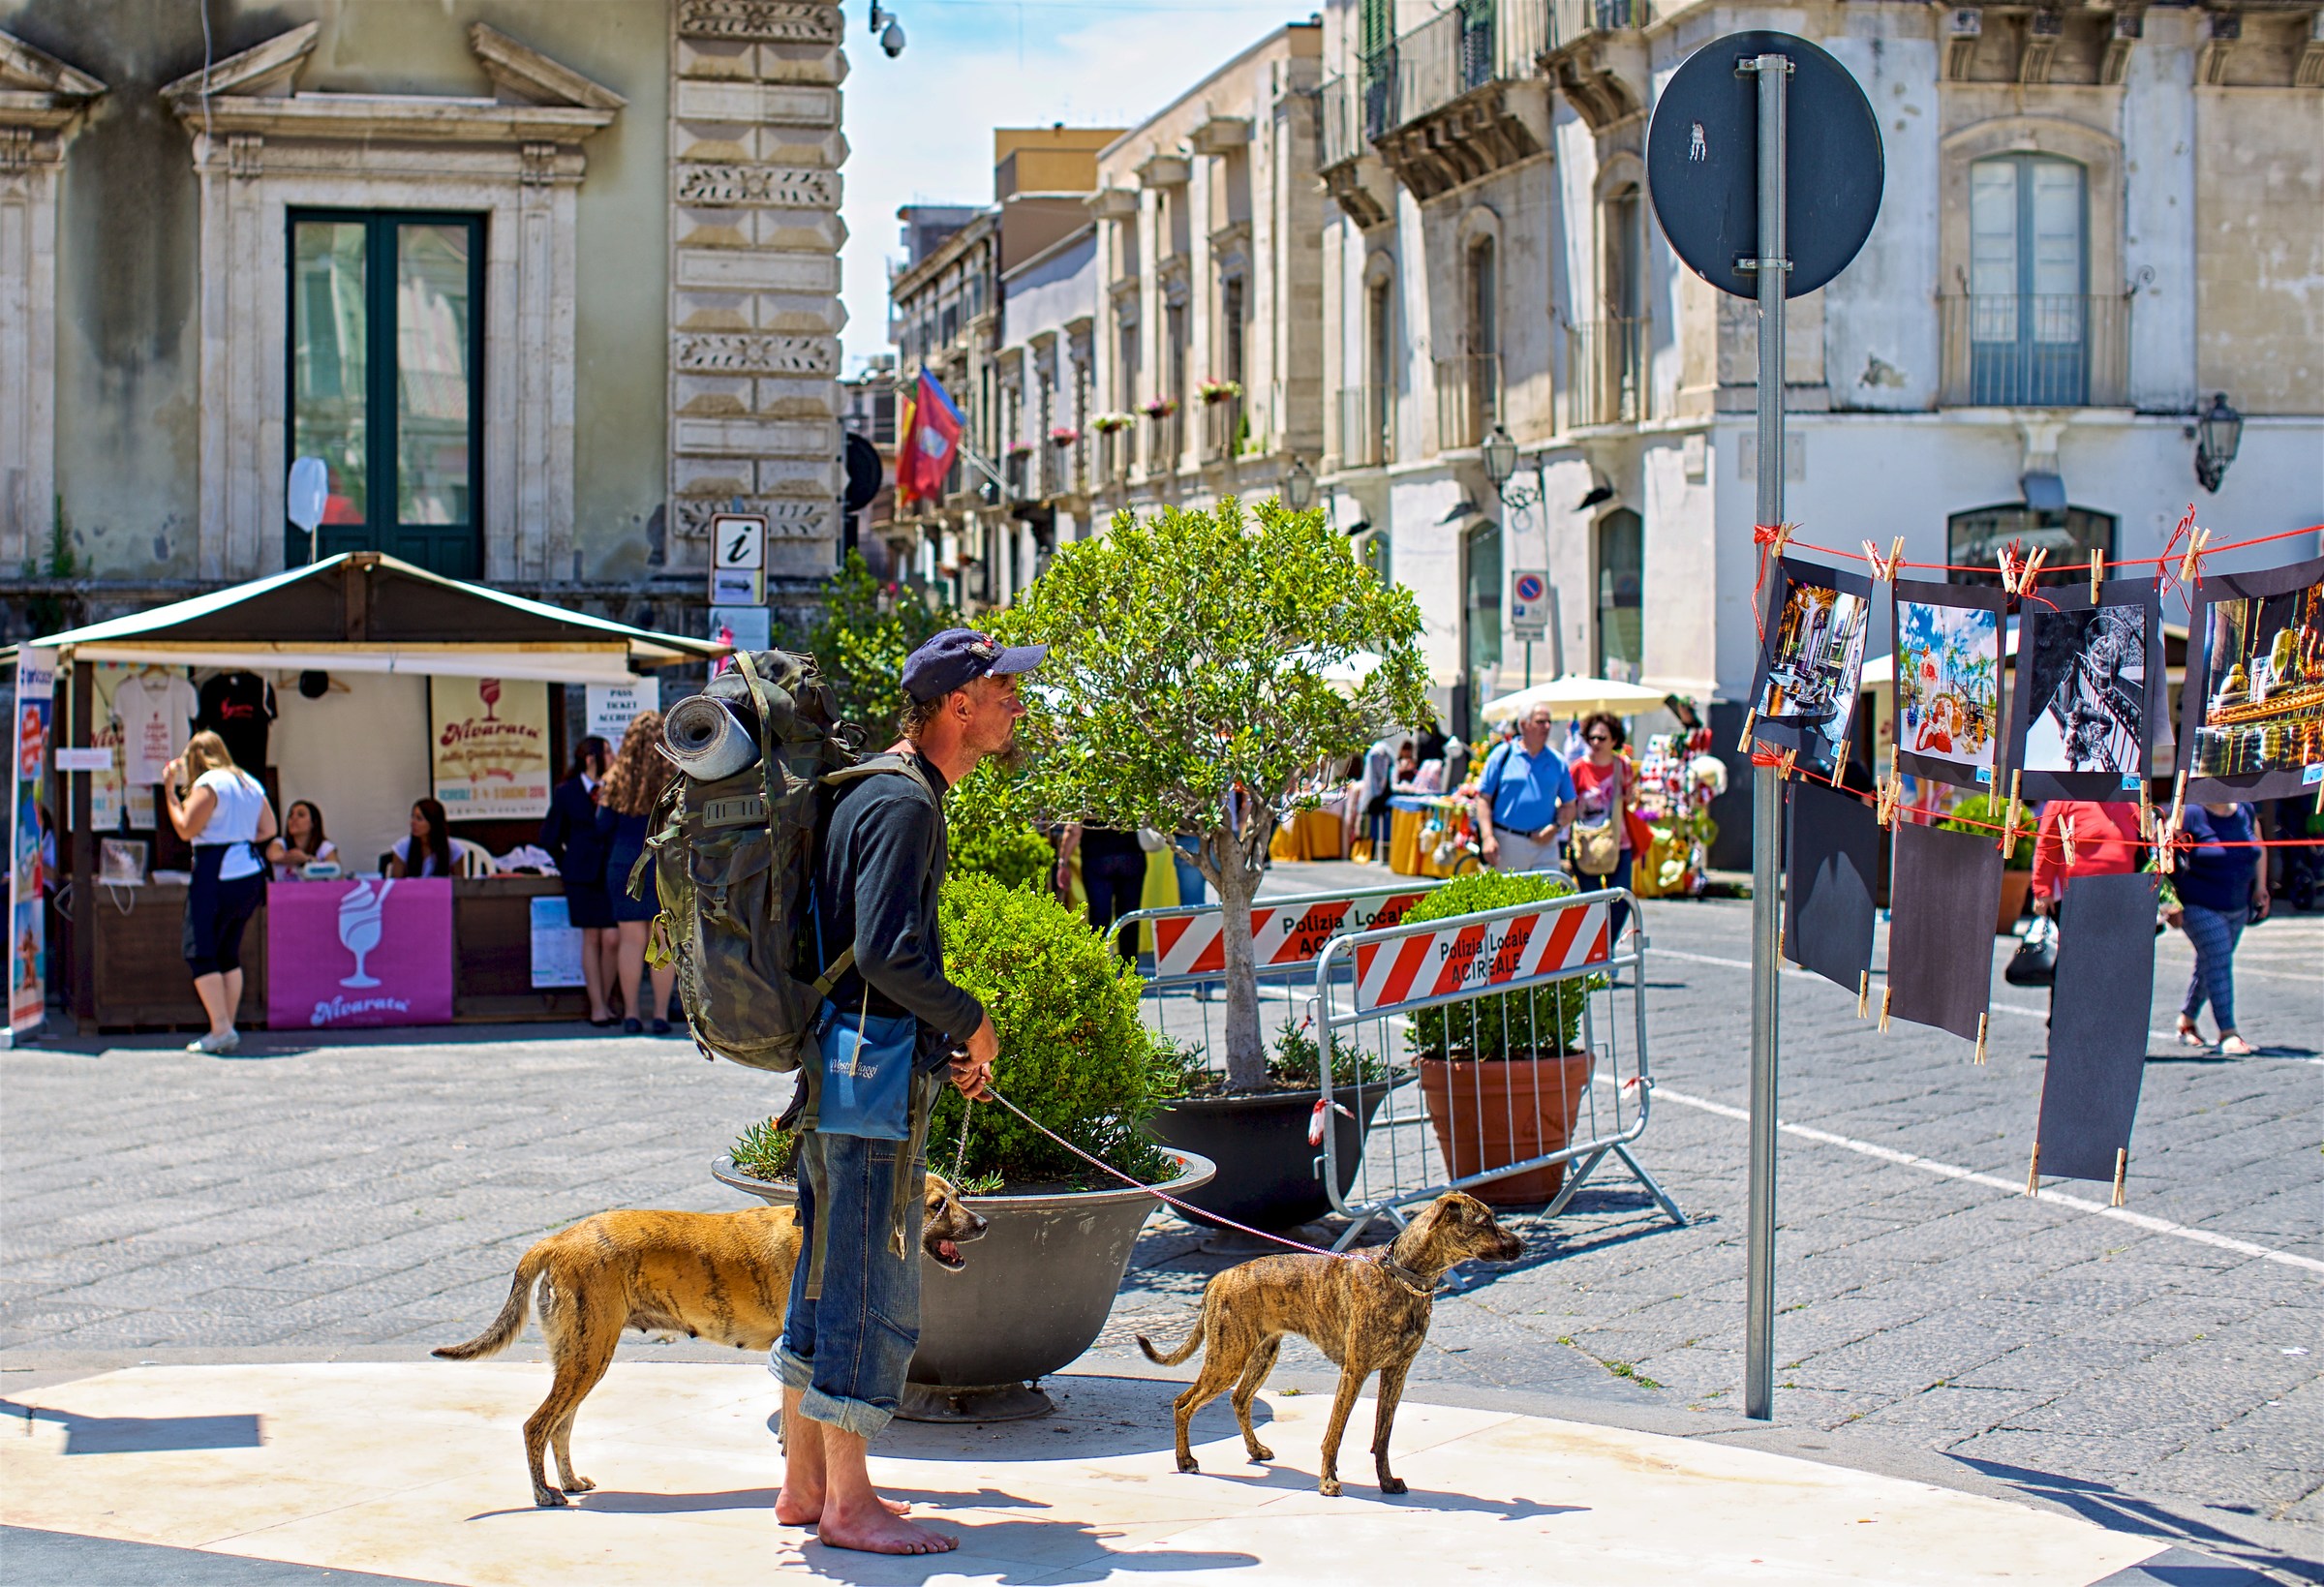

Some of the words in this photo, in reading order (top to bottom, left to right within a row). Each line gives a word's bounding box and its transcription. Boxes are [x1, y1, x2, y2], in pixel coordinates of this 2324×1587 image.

[726, 526, 751, 563] i
[1282, 913, 1345, 935] Polizia
[1355, 905, 1404, 928] Local
[1440, 936, 1483, 961] Polizia
[1489, 928, 1530, 952] Locale
[1452, 953, 1521, 985] ACIREALE
